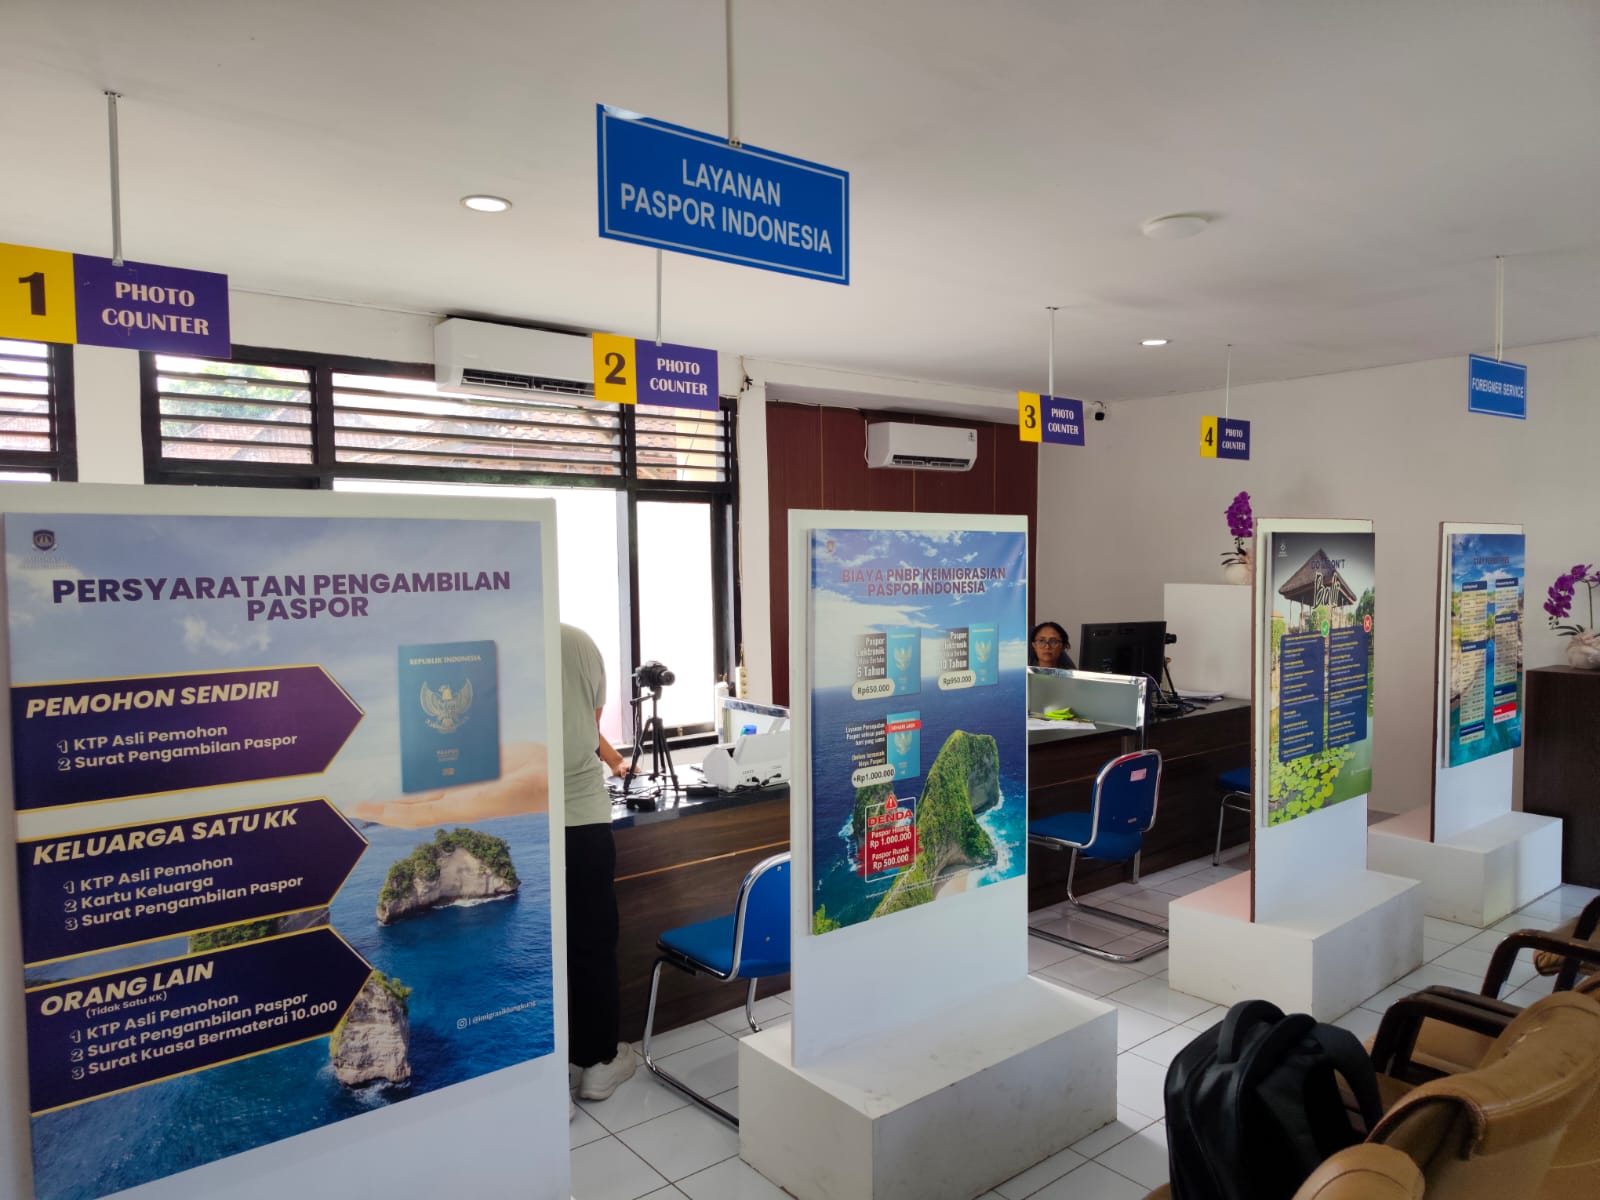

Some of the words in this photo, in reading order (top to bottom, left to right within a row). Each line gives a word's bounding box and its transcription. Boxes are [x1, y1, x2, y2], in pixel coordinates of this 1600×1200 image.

[682, 158, 781, 207] LAYANAN
[621, 183, 716, 229] PASPOR
[722, 206, 832, 254] INDONESIA
[18, 271, 46, 316] 1
[115, 281, 195, 307] PHOTO
[102, 308, 209, 336] COUNTER
[604, 352, 626, 385] 2
[657, 358, 700, 375] PHOTO
[649, 377, 708, 396] COUNTER
[1472, 377, 1502, 395] FOREIGNER
[1503, 383, 1524, 399] SERVICE
[1024, 405, 1036, 429] 3
[1051, 408, 1074, 420] PHOTO
[1048, 422, 1079, 435] COUNTER
[1204, 427, 1213, 447] 4
[1225, 428, 1243, 438] PHOTO
[1222, 440, 1246, 451] COUNTER
[52, 574, 306, 604] PERSYARATAN
[313, 571, 511, 596] PENGAMBILAN
[842, 568, 884, 584] BIAYA
[886, 568, 921, 582] PNBP
[922, 567, 1007, 582] KEIMIGRASIAN
[867, 582, 919, 597] PASPOR
[921, 581, 986, 596] INDONESIA
[247, 596, 369, 621] PASPOR
[864, 666, 885, 677] Tahun
[949, 659, 967, 669] Tahun
[26, 689, 175, 719] PEMOHON
[180, 680, 280, 705] SENDIRI
[857, 684, 890, 696] Rp650.000
[56, 739, 68, 754] 1
[74, 736, 108, 751] KTP
[112, 731, 144, 748] Asli
[148, 725, 228, 744] Pemohon
[57, 757, 71, 771] 2
[75, 753, 124, 769] Surat
[128, 739, 241, 763] Pengambilan
[244, 735, 298, 754] Paspor
[867, 809, 913, 827] DENDA
[33, 825, 185, 866] KELUARGA
[191, 813, 260, 840] SATU
[263, 808, 299, 830] KK
[869, 840, 879, 850] Rp
[881, 832, 912, 846] 1.000.000
[871, 829, 891, 840] Paspor
[872, 852, 891, 862] Paspor
[892, 845, 910, 855] Rusak
[872, 861, 883, 871] Rp
[883, 854, 909, 867] 500.000
[62, 880, 75, 895] 1
[80, 876, 114, 892] KTP
[118, 869, 150, 886] Asli
[154, 855, 233, 880] Pemohon
[63, 899, 77, 913] 2
[81, 891, 132, 910] Kartu
[135, 875, 214, 899] Keluarga
[64, 917, 78, 931] 3
[82, 908, 132, 927] Surat
[135, 886, 247, 918] Pengambilan
[250, 875, 304, 899] Paspor
[40, 975, 147, 1017] ORANG
[152, 960, 215, 992] LAIN
[86, 1002, 120, 1019] (Tidak
[123, 996, 148, 1009] Satu
[148, 991, 168, 1004] KK)
[69, 1029, 81, 1044] 1
[87, 1022, 121, 1040] KTP
[124, 1012, 157, 1031] Asli
[160, 993, 239, 1022] Pemohon
[70, 1048, 84, 1063] 2
[87, 1036, 137, 1058] Surat
[140, 1007, 252, 1043] Pengambilan
[254, 992, 309, 1019] Paspor
[71, 1066, 85, 1080] 3
[88, 1054, 138, 1076] Surat
[140, 1041, 195, 1062] Kuasa
[198, 1012, 289, 1048] Bermaterai
[291, 999, 338, 1024] 10.000
